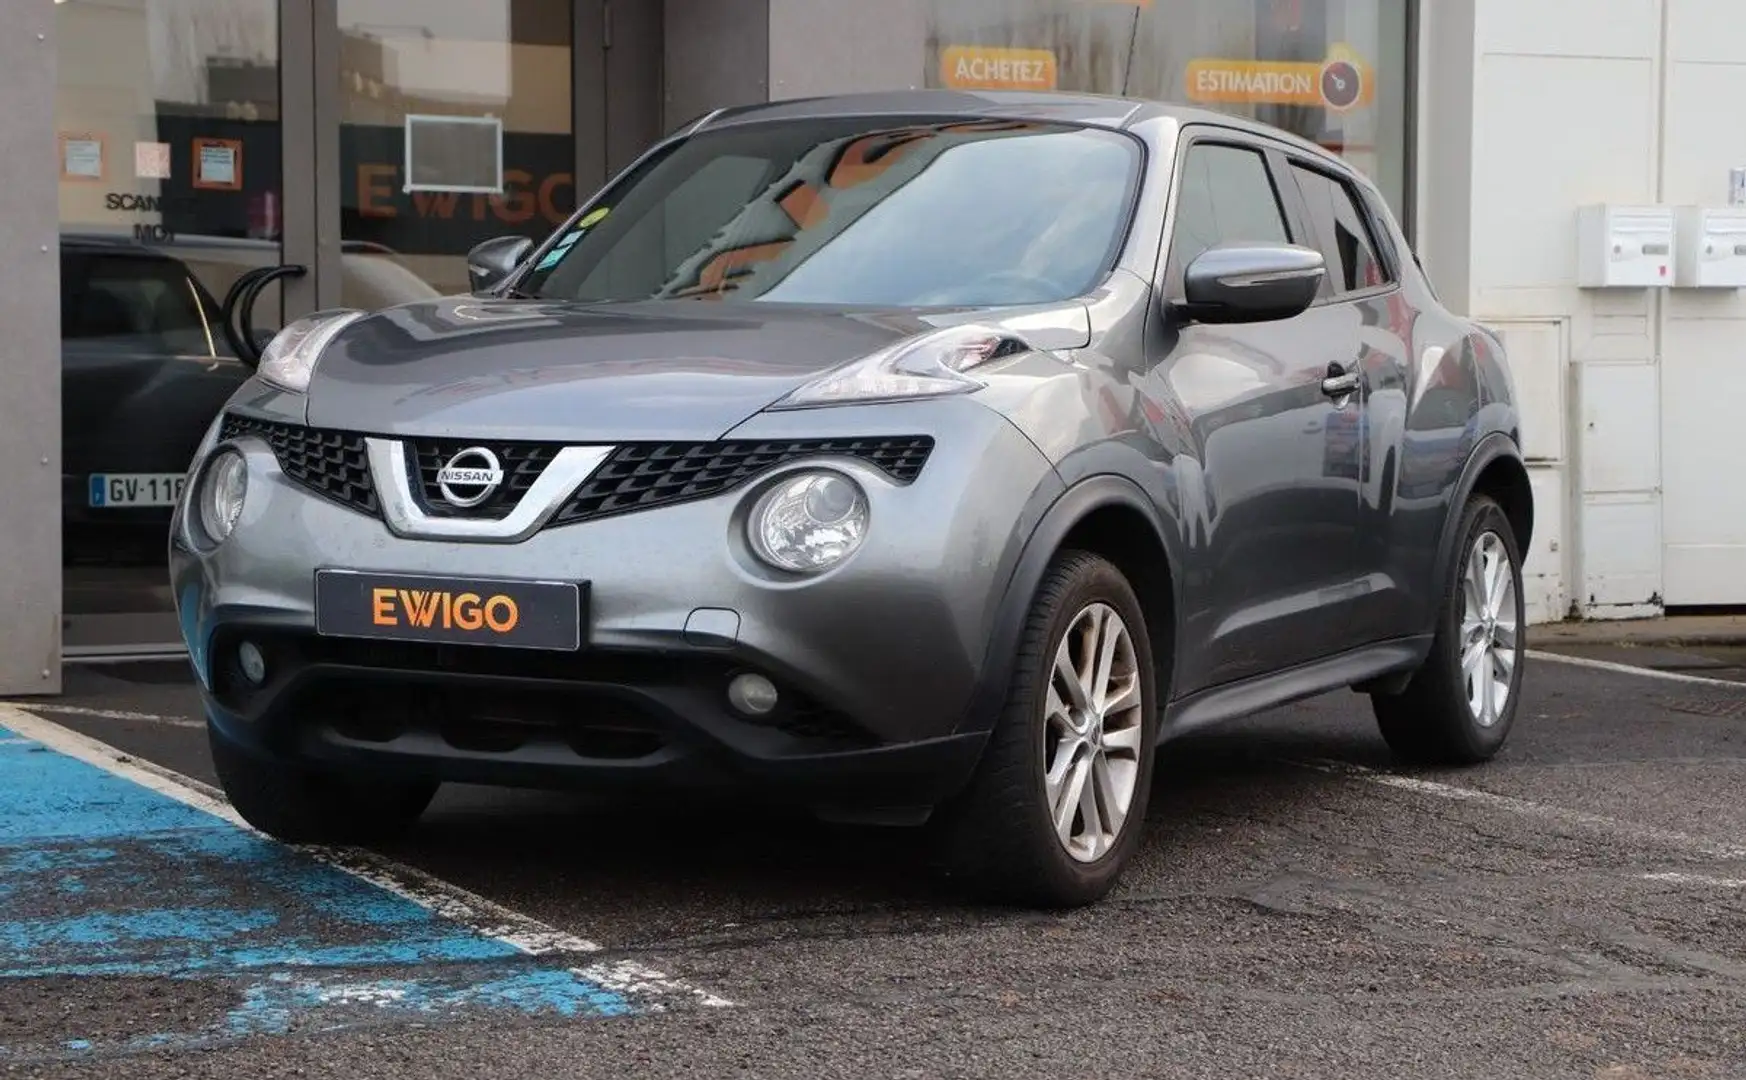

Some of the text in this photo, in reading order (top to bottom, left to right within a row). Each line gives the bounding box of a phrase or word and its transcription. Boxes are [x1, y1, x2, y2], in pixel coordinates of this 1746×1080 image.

[955, 56, 1046, 82] ACHETEZ
[1196, 69, 1313, 95] ESTIMATION
[440, 470, 494, 482] NISSAN
[372, 587, 519, 633] EWIGO
